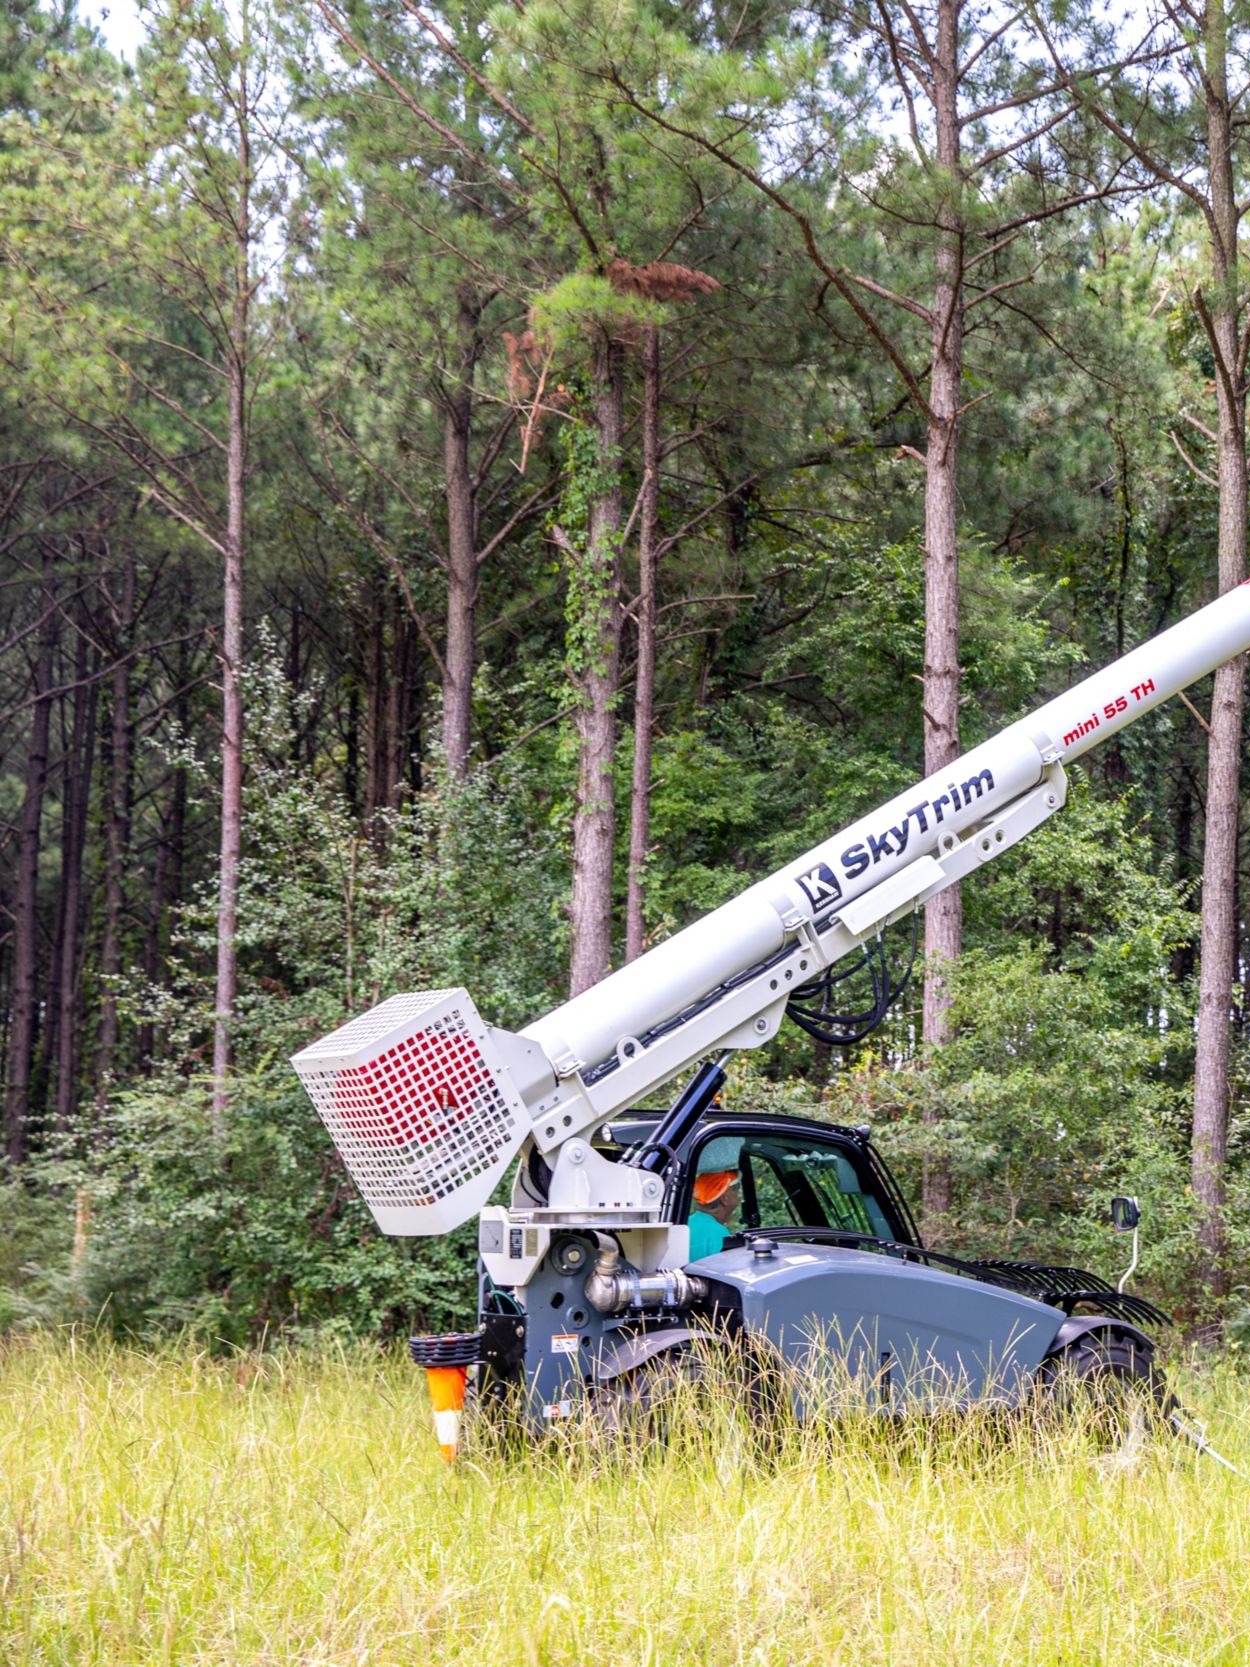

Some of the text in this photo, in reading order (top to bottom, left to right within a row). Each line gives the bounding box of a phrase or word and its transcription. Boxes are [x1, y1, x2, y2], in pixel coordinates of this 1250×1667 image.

[1063, 678, 1155, 746] mini 55 TH
[840, 768, 995, 880] SkyTrim
[800, 868, 838, 901] K
